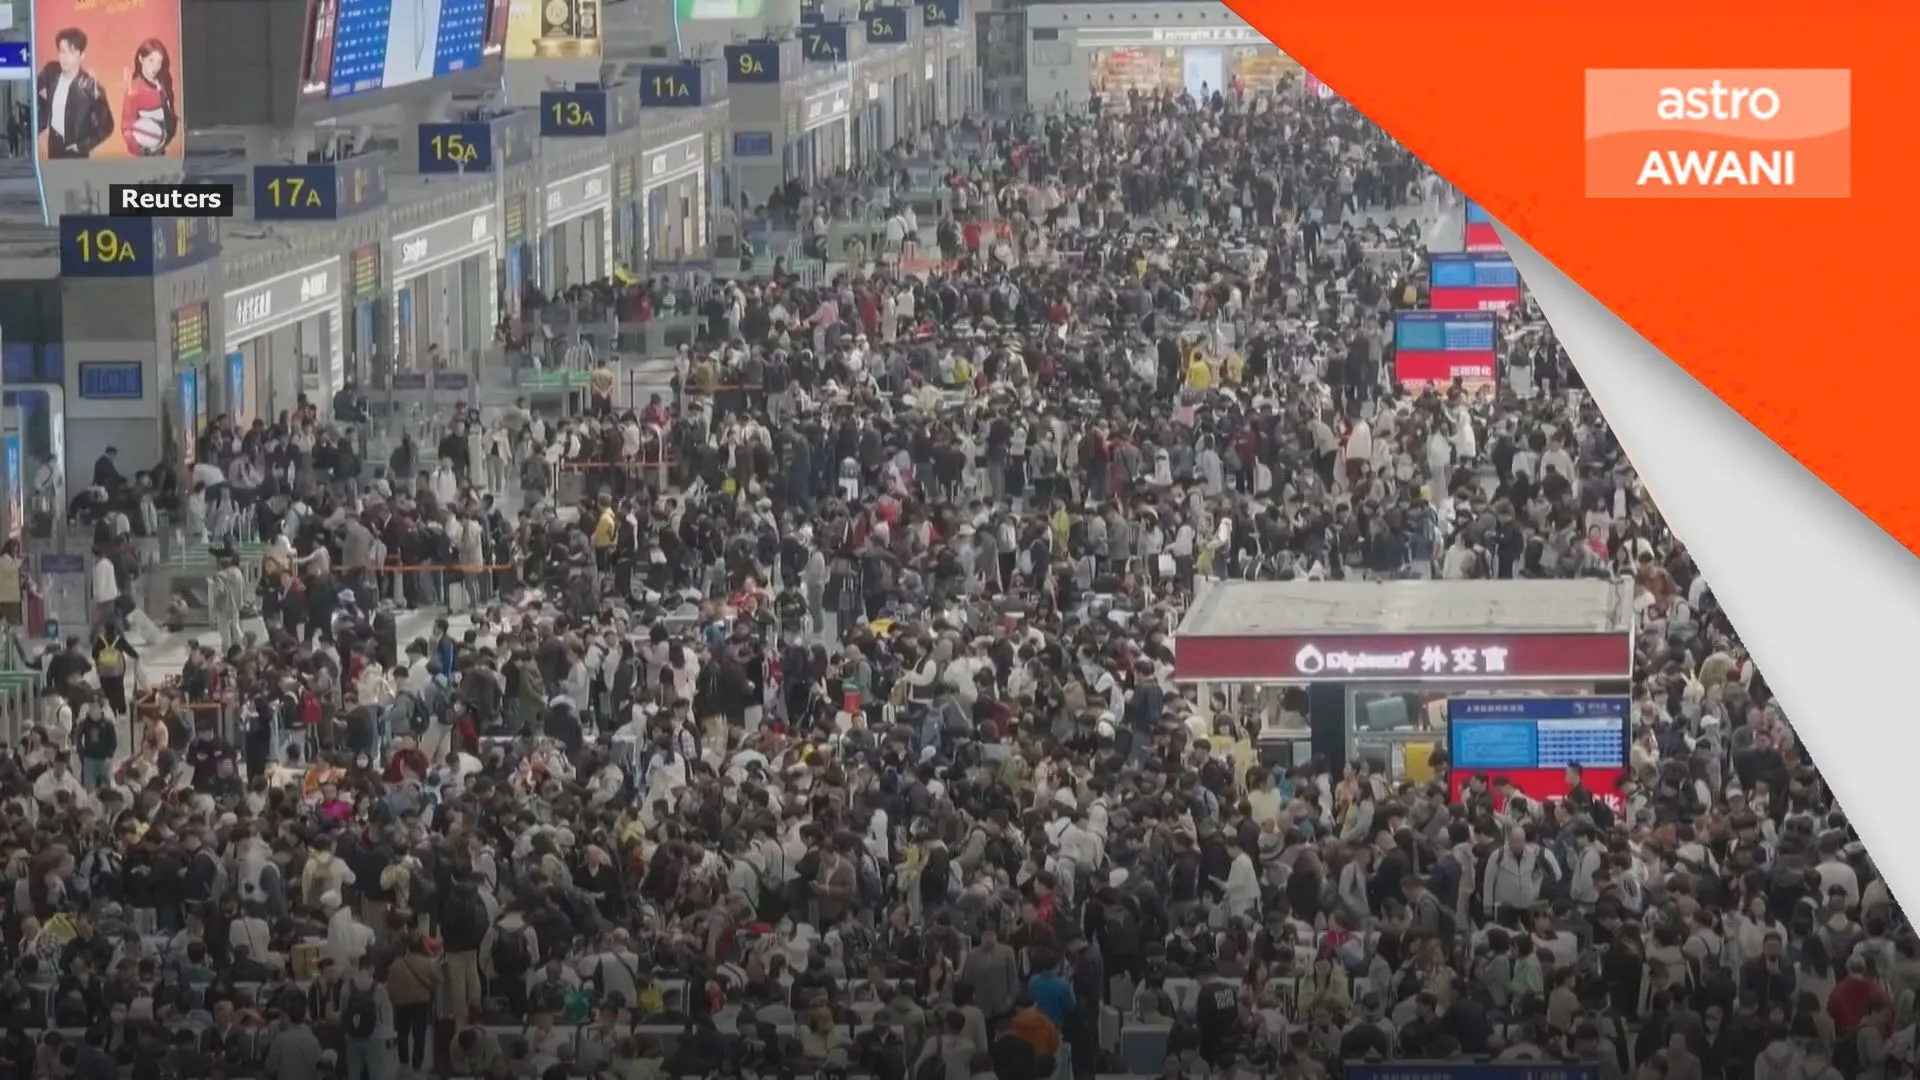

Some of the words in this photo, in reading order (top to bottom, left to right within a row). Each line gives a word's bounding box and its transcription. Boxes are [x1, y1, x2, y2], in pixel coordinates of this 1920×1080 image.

[927, 3, 947, 21] 3A
[871, 18, 893, 36] 5A
[809, 36, 831, 55] 7A
[739, 53, 763, 74] 9A
[652, 76, 690, 97] 11A
[551, 102, 594, 127] 13A
[431, 134, 477, 161] 15A
[267, 176, 321, 207] 17A
[76, 228, 136, 263] 19A
[1421, 644, 1508, 673] 外交官
